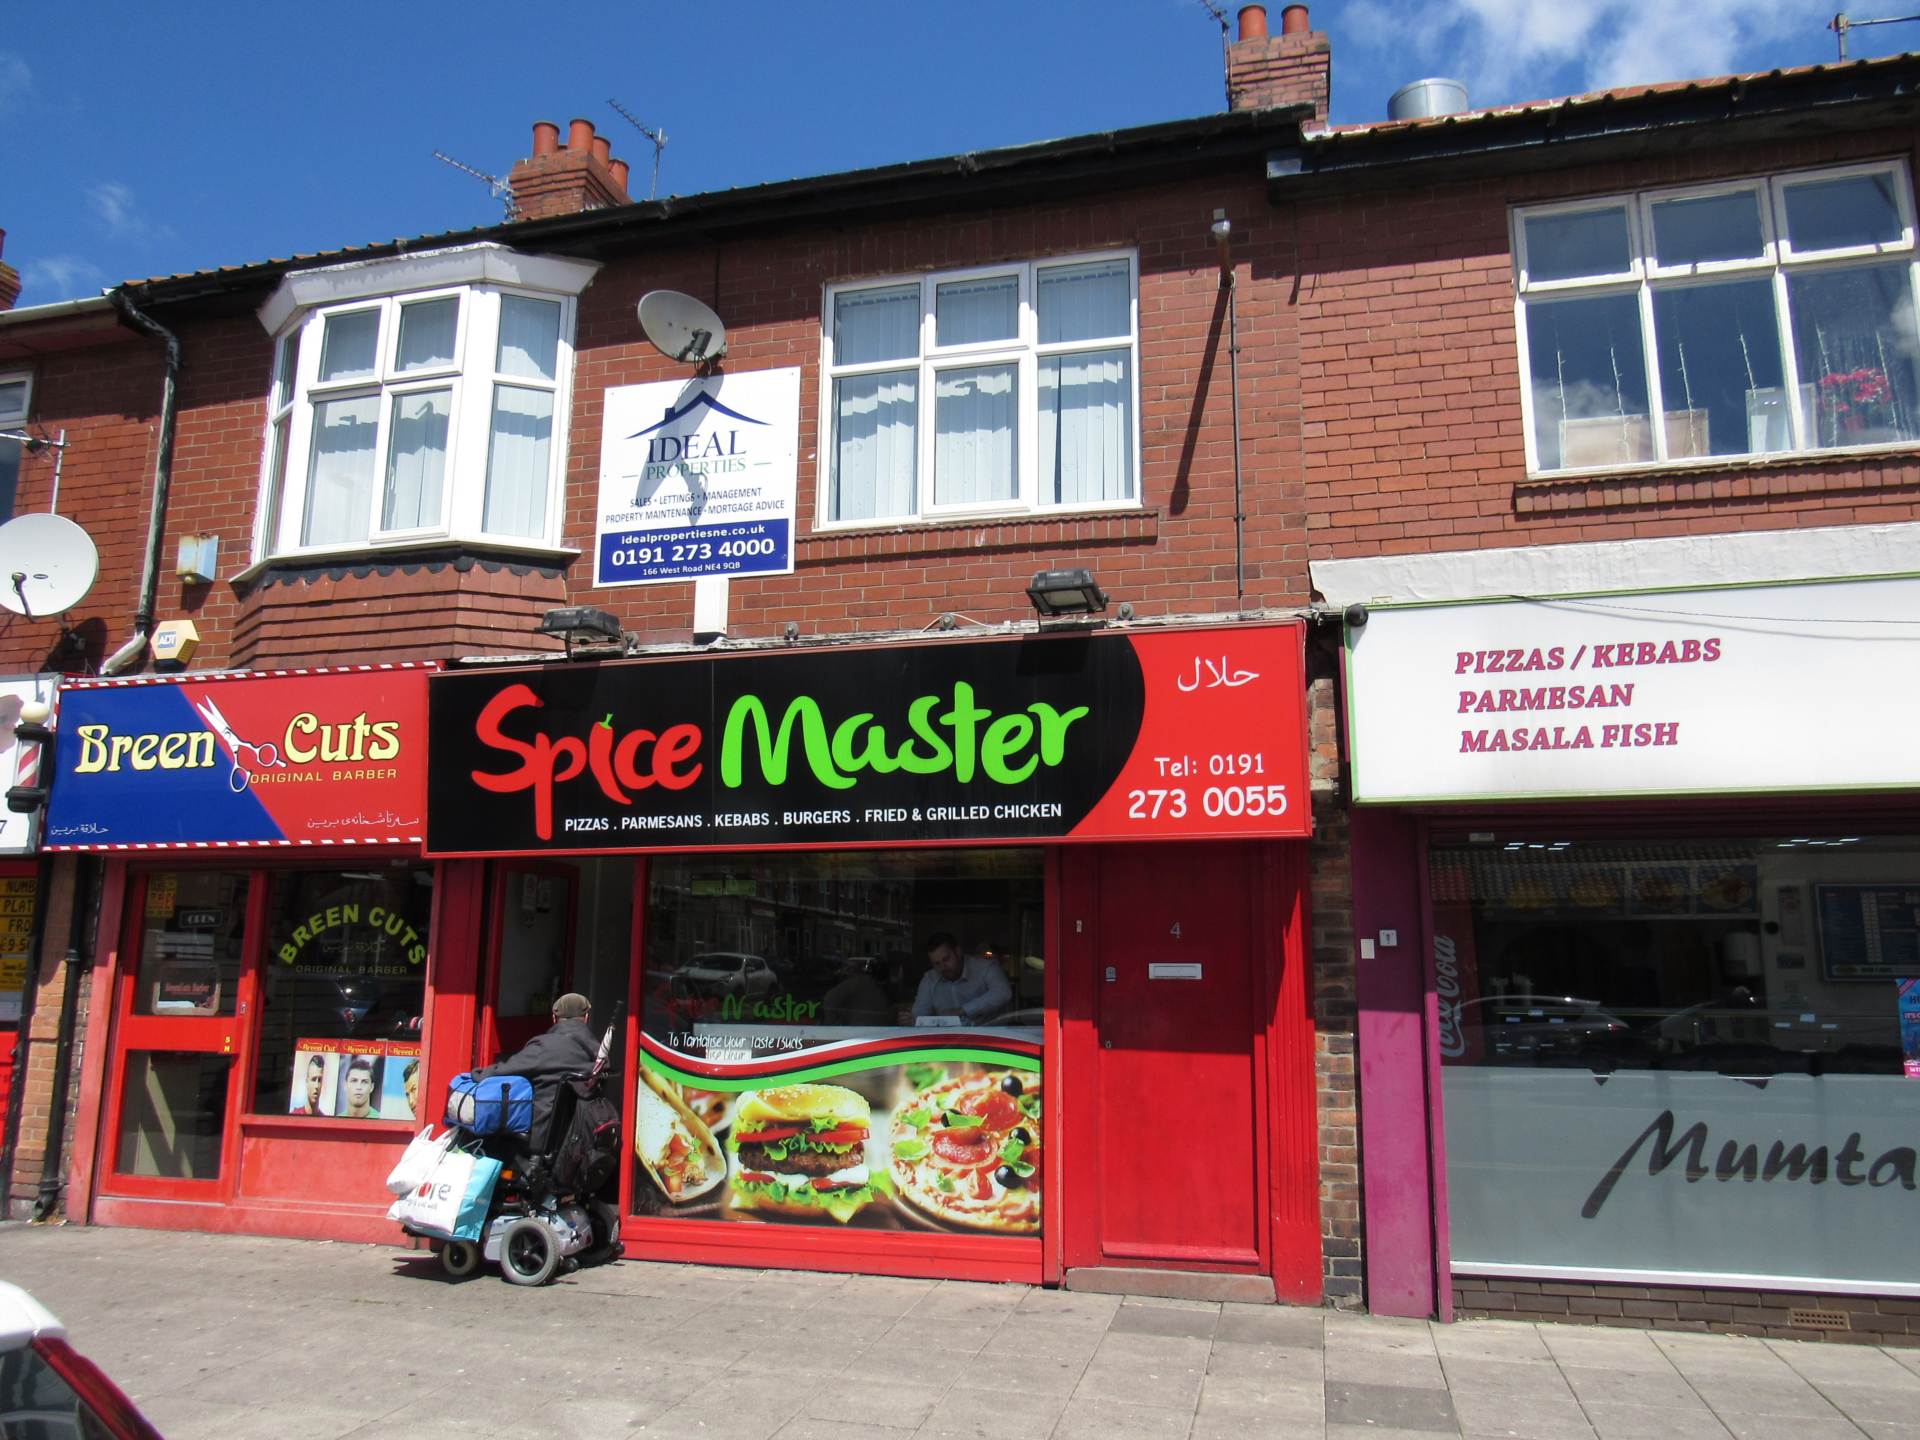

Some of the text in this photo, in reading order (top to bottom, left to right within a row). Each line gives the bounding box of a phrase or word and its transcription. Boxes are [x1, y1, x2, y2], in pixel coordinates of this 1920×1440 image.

[647, 430, 747, 464] IDEAL
[646, 458, 746, 480] PROPERTIES
[605, 500, 785, 524] PROPERTY MAINTENANCE MORTGAGE ADVICE
[630, 488, 762, 508] SALES LETTINGS MANAGEMENT
[621, 524, 765, 545] idealpropertiesne.co.uk
[612, 538, 775, 566] 0191 273 4000
[643, 567, 658, 576] 166
[660, 566, 681, 576] West
[682, 564, 703, 573] Road
[704, 563, 721, 571] NE4
[1455, 647, 1565, 675] PIZZAS
[1592, 638, 1721, 669] KEBABS
[1177, 655, 1260, 692] حلال
[1457, 683, 1634, 714] PARMESAN
[75, 712, 400, 774] Breen Cuts
[1460, 722, 1679, 753] MASALA FISH
[471, 680, 1090, 840] Spice Master
[1153, 753, 1264, 777] Tel: 0191
[250, 768, 398, 785] ORIGINAL BARBER
[1128, 785, 1287, 819] 273 0055
[565, 803, 1062, 831] PIZZAS PARMESANS KEBABS BURGERS FRIED & GRILLED CHICKEN
[278, 904, 426, 965] BREEN CUTS
[1170, 921, 1181, 938] 4
[296, 964, 407, 976] ORIGINAL BARBER
[668, 1032, 679, 1047] To
[1580, 1109, 1917, 1219] Mumta
